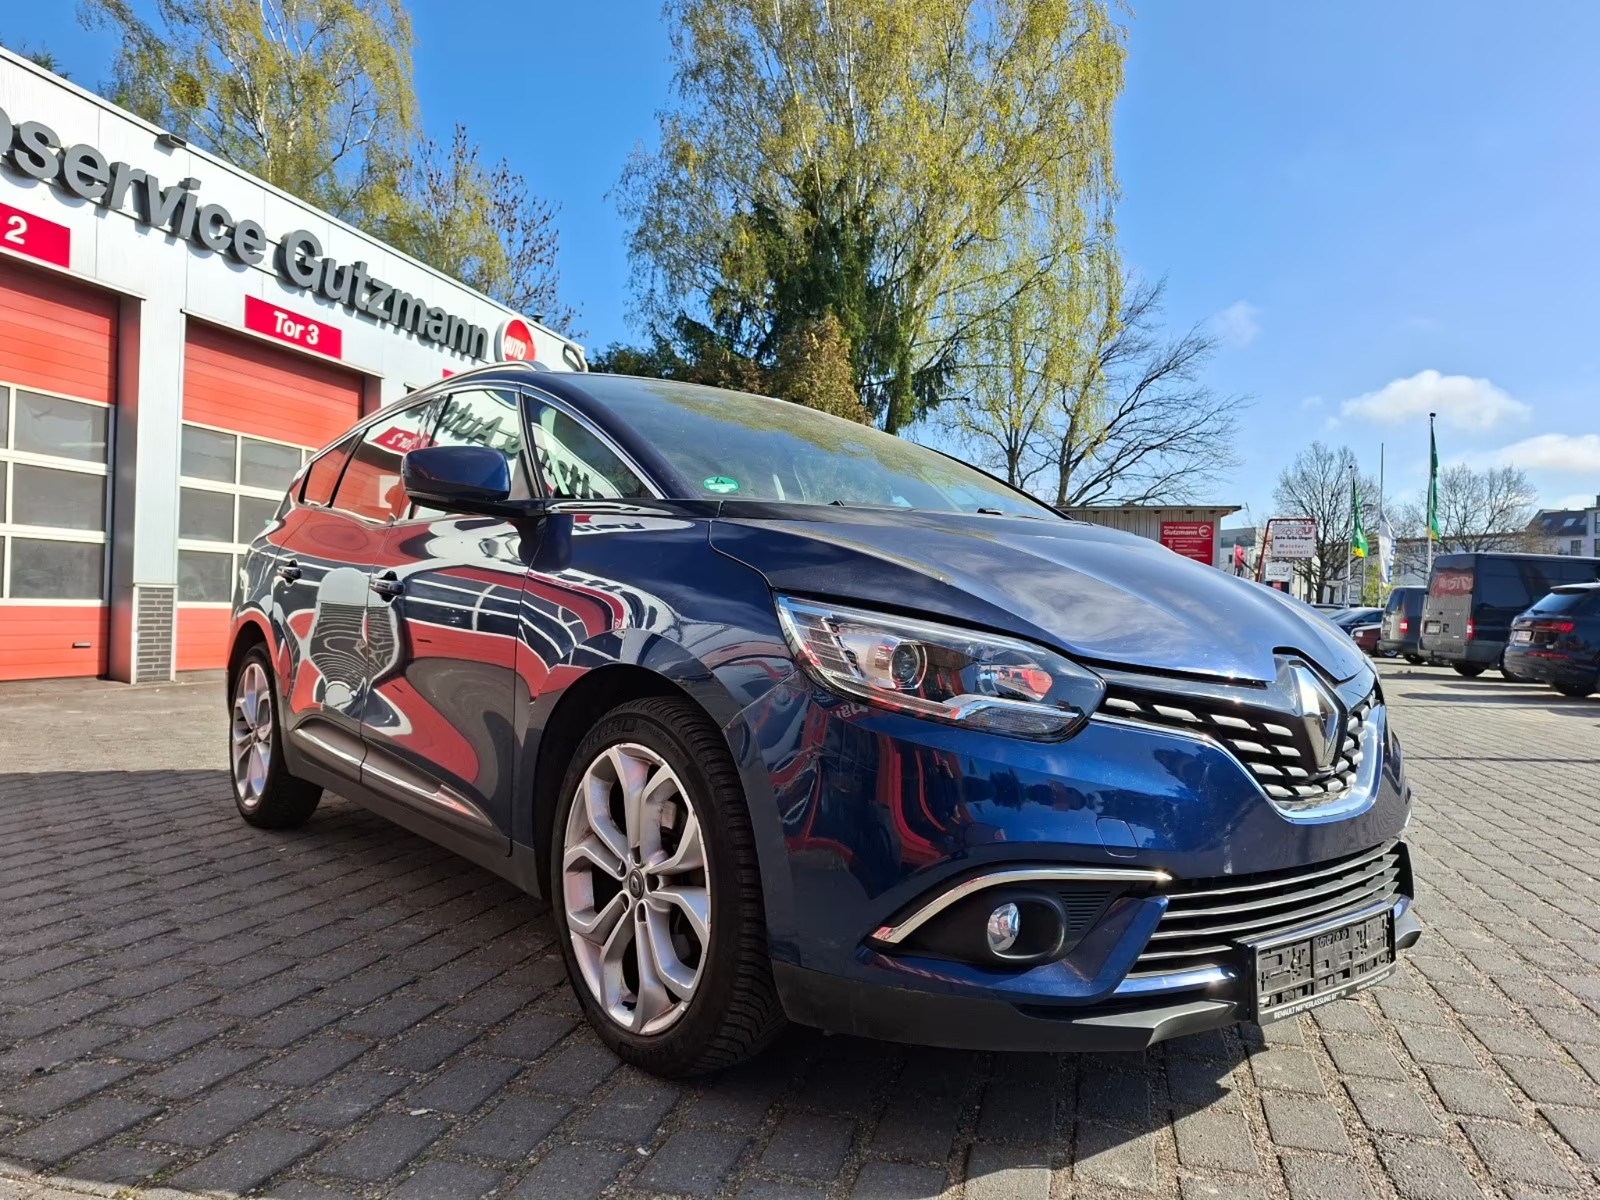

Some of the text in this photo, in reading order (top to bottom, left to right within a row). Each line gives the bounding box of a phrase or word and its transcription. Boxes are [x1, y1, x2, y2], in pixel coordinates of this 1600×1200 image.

[0, 106, 489, 361] service Gutzmann
[4, 215, 29, 245] 2
[273, 311, 320, 345] Tor 3
[504, 335, 527, 360] AUTO
[1274, 1006, 1297, 1019] RENAULT
